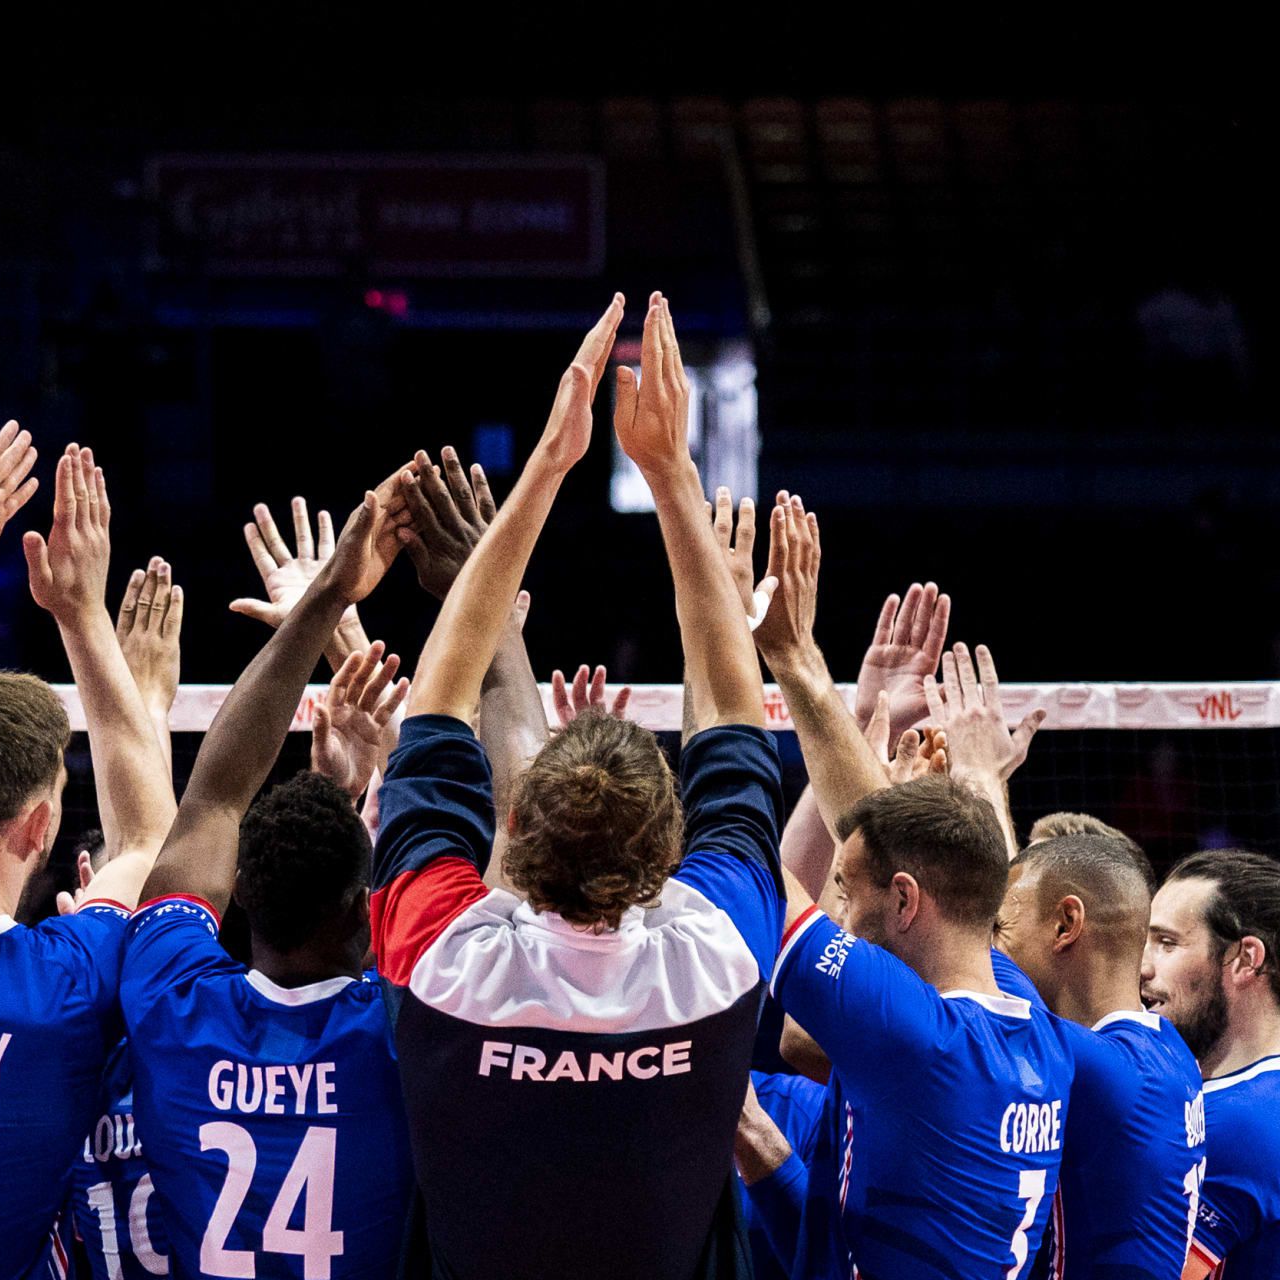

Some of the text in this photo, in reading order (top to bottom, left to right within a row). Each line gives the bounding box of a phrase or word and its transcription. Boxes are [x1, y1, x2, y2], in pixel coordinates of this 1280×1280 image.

[1196, 690, 1243, 720] VNL
[478, 1040, 693, 1082] FRANCE
[208, 1060, 339, 1115] GUEYE
[83, 1113, 143, 1163] LOU
[1000, 1100, 1062, 1154] CORRE
